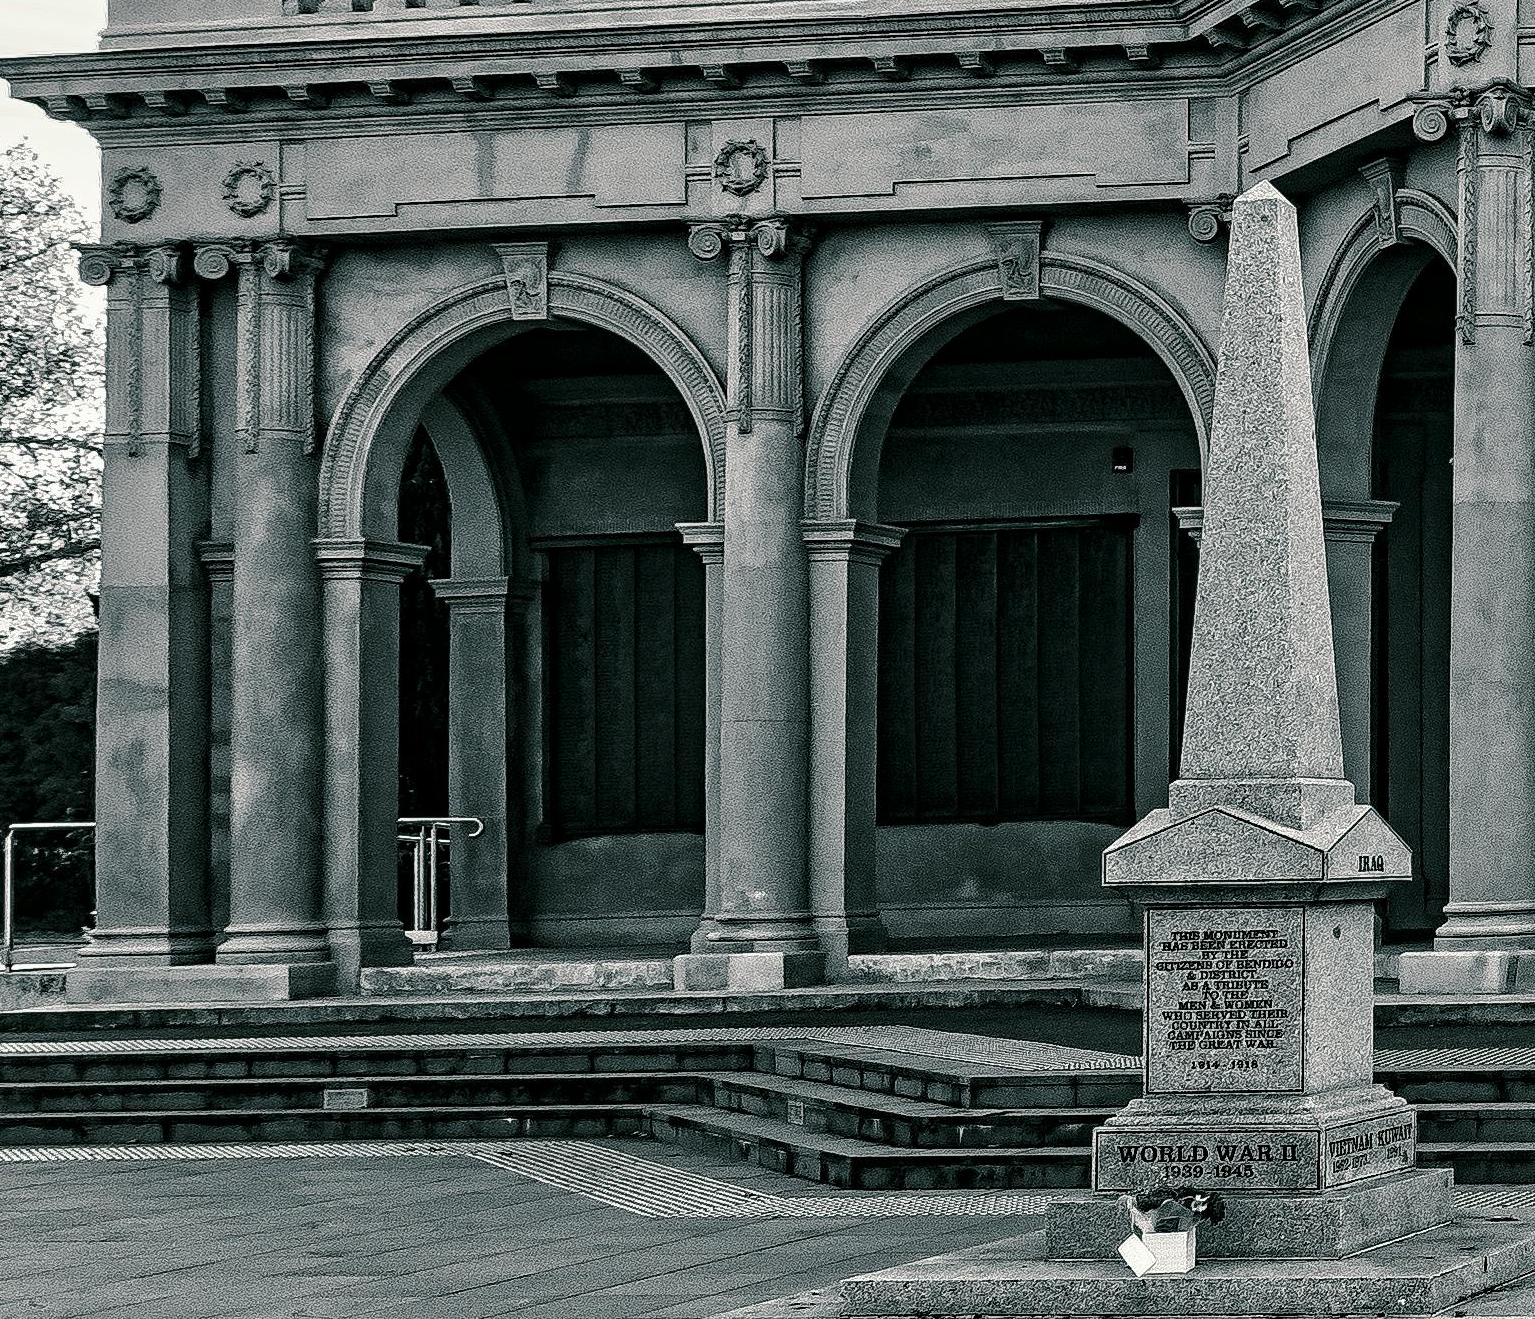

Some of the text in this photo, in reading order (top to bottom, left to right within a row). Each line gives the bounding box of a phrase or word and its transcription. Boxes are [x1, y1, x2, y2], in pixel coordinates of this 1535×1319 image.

[1358, 855, 1384, 872] IRAQ
[1171, 930, 1278, 941] THIS MONUMENT
[1162, 940, 1288, 951] HAS BEEN ERECTED
[1202, 950, 1248, 960] BY THE
[1156, 959, 1294, 971] CITIZENS OF BENDIGO
[1186, 971, 1196, 980] &
[1182, 980, 1268, 990] AS A TRIBUTE
[1202, 991, 1249, 1000] TO THE
[1178, 1000, 1272, 1010] MEN & WOMEN
[1162, 1010, 1289, 1020] WHO SERVED THEIR
[1172, 1020, 1278, 1030] COUNTRY IN ALL
[1167, 1030, 1283, 1040] CAMPAIGNS SINCE
[1169, 1041, 1195, 1050] THE
[1199, 1040, 1242, 1049] GREAT
[1329, 1123, 1412, 1158] VIETNAM KUWAIT
[1118, 1144, 1298, 1163] WORLD WAR II
[1165, 1164, 1254, 1178] 1939-1945
